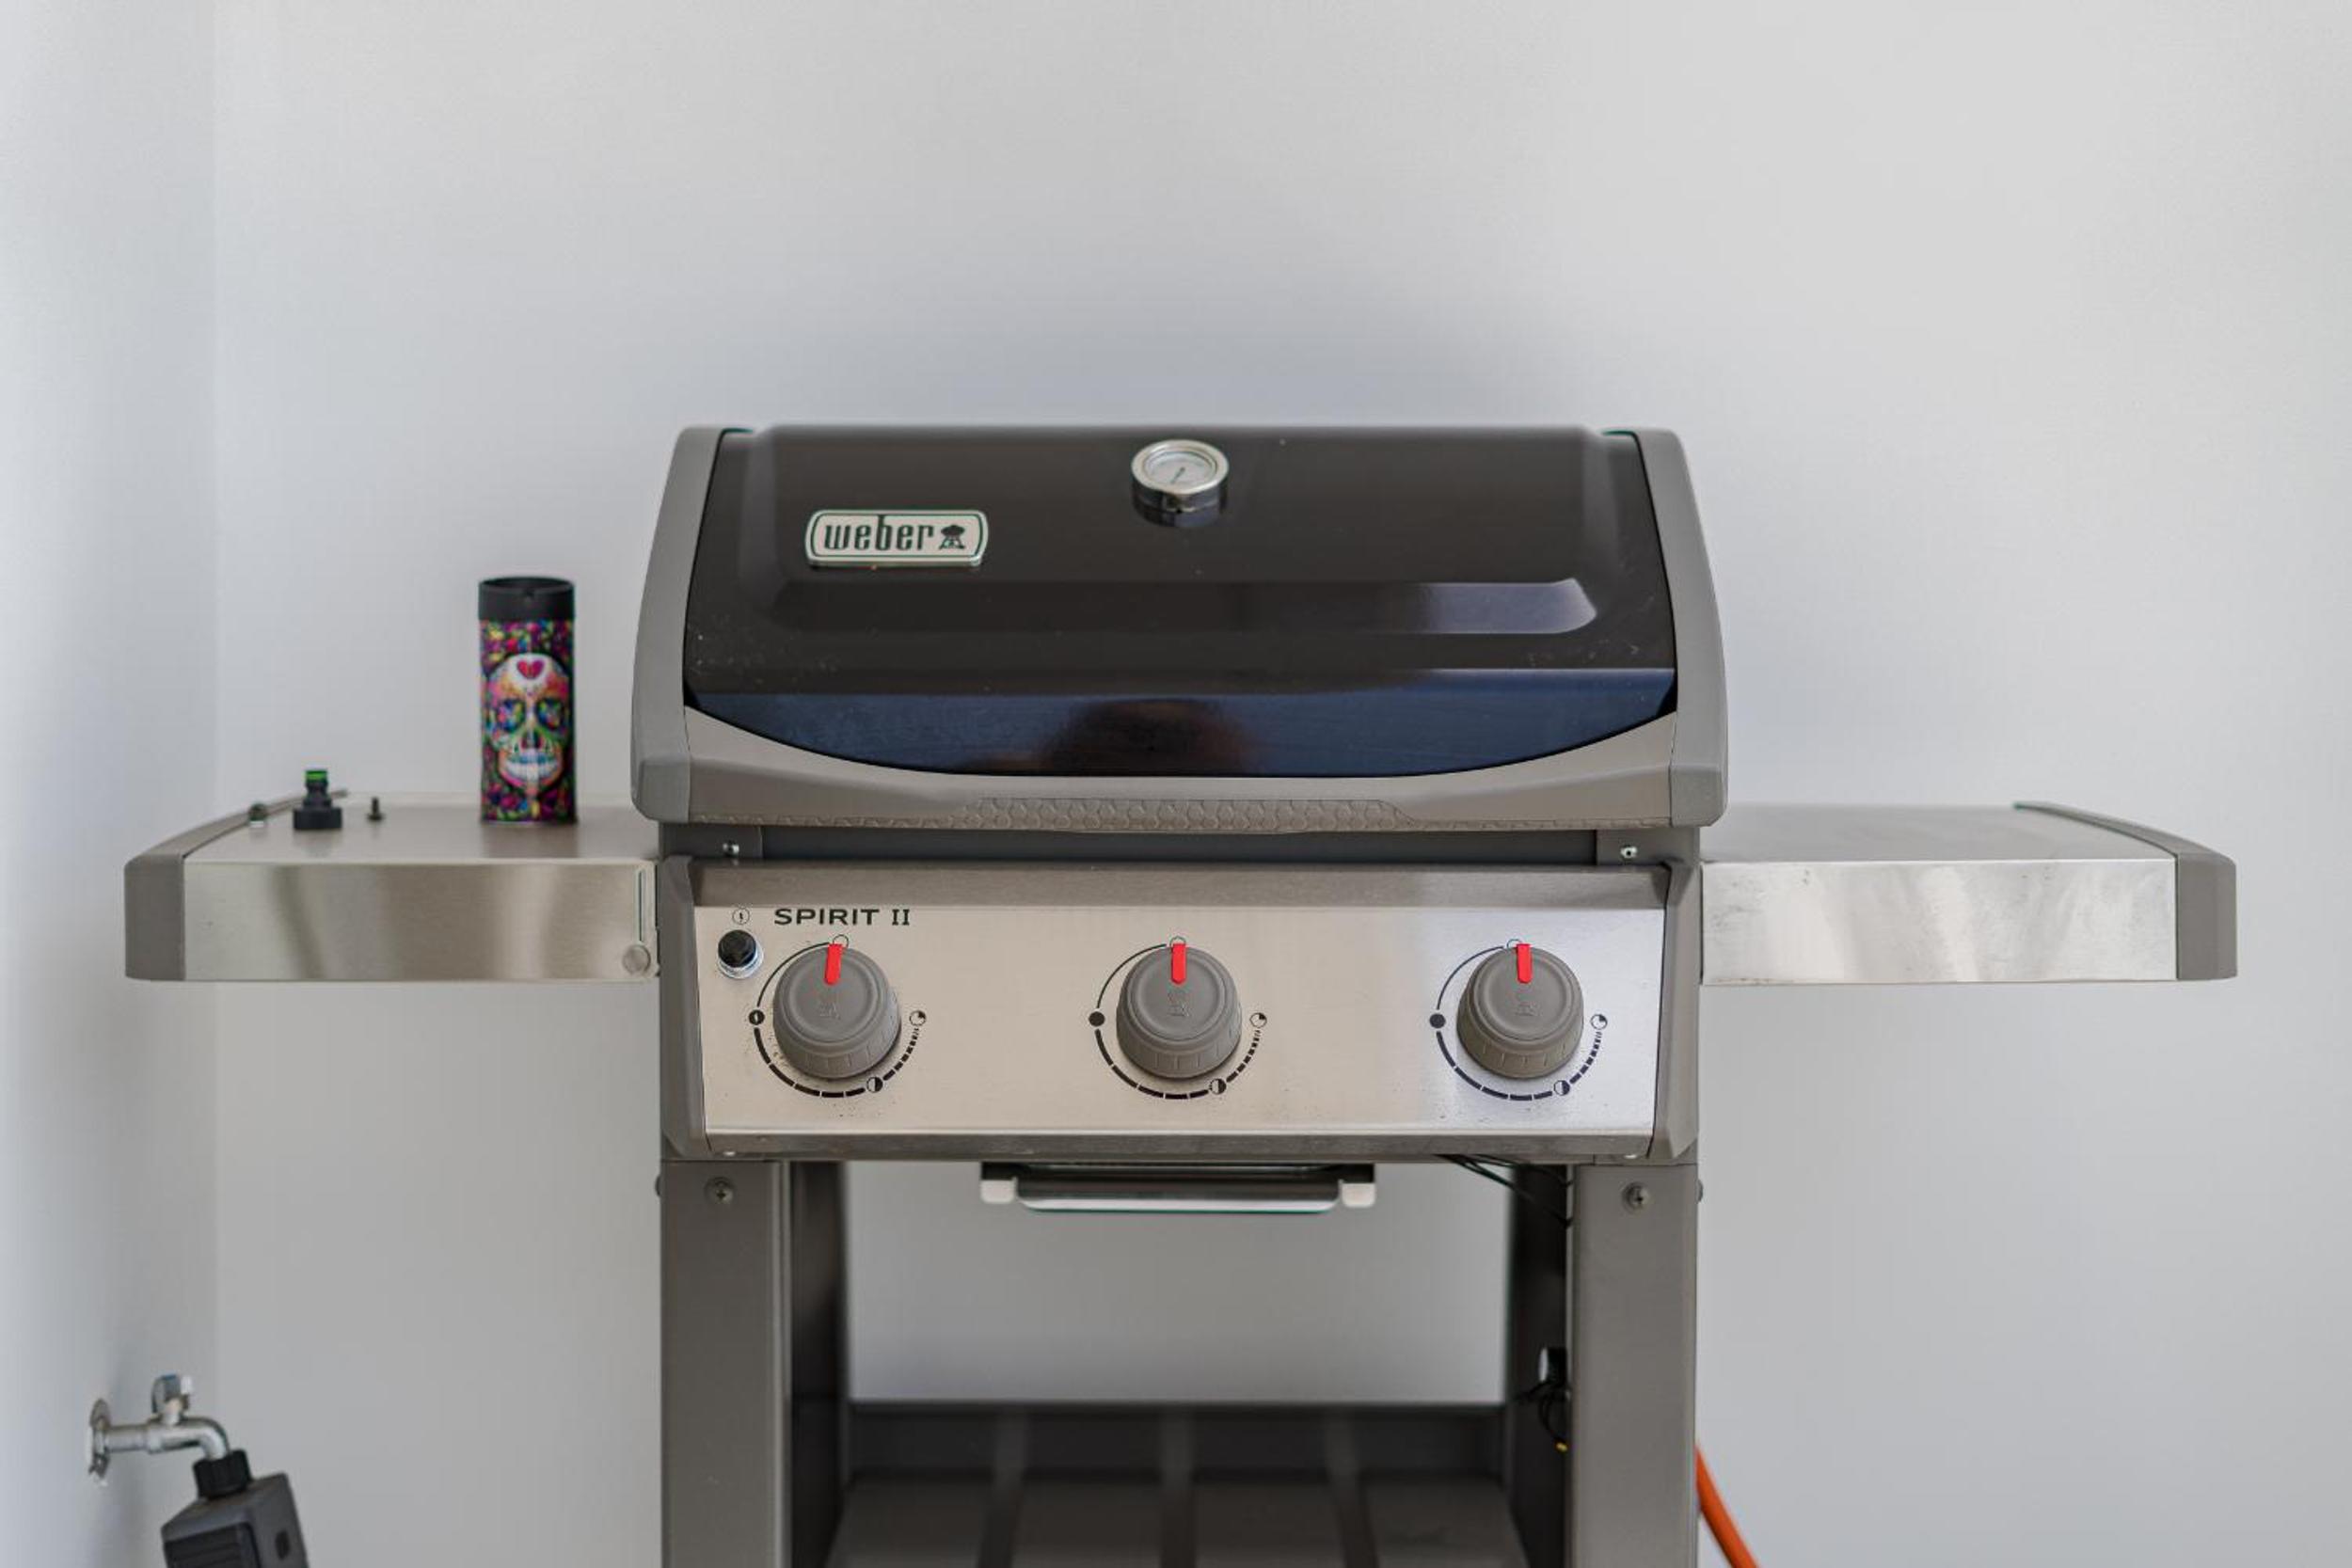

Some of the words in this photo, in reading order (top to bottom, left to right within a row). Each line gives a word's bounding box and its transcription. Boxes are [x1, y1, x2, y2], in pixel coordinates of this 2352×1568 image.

[823, 515, 934, 551] weber
[773, 908, 880, 926] SPIRIT
[891, 908, 911, 927] II
